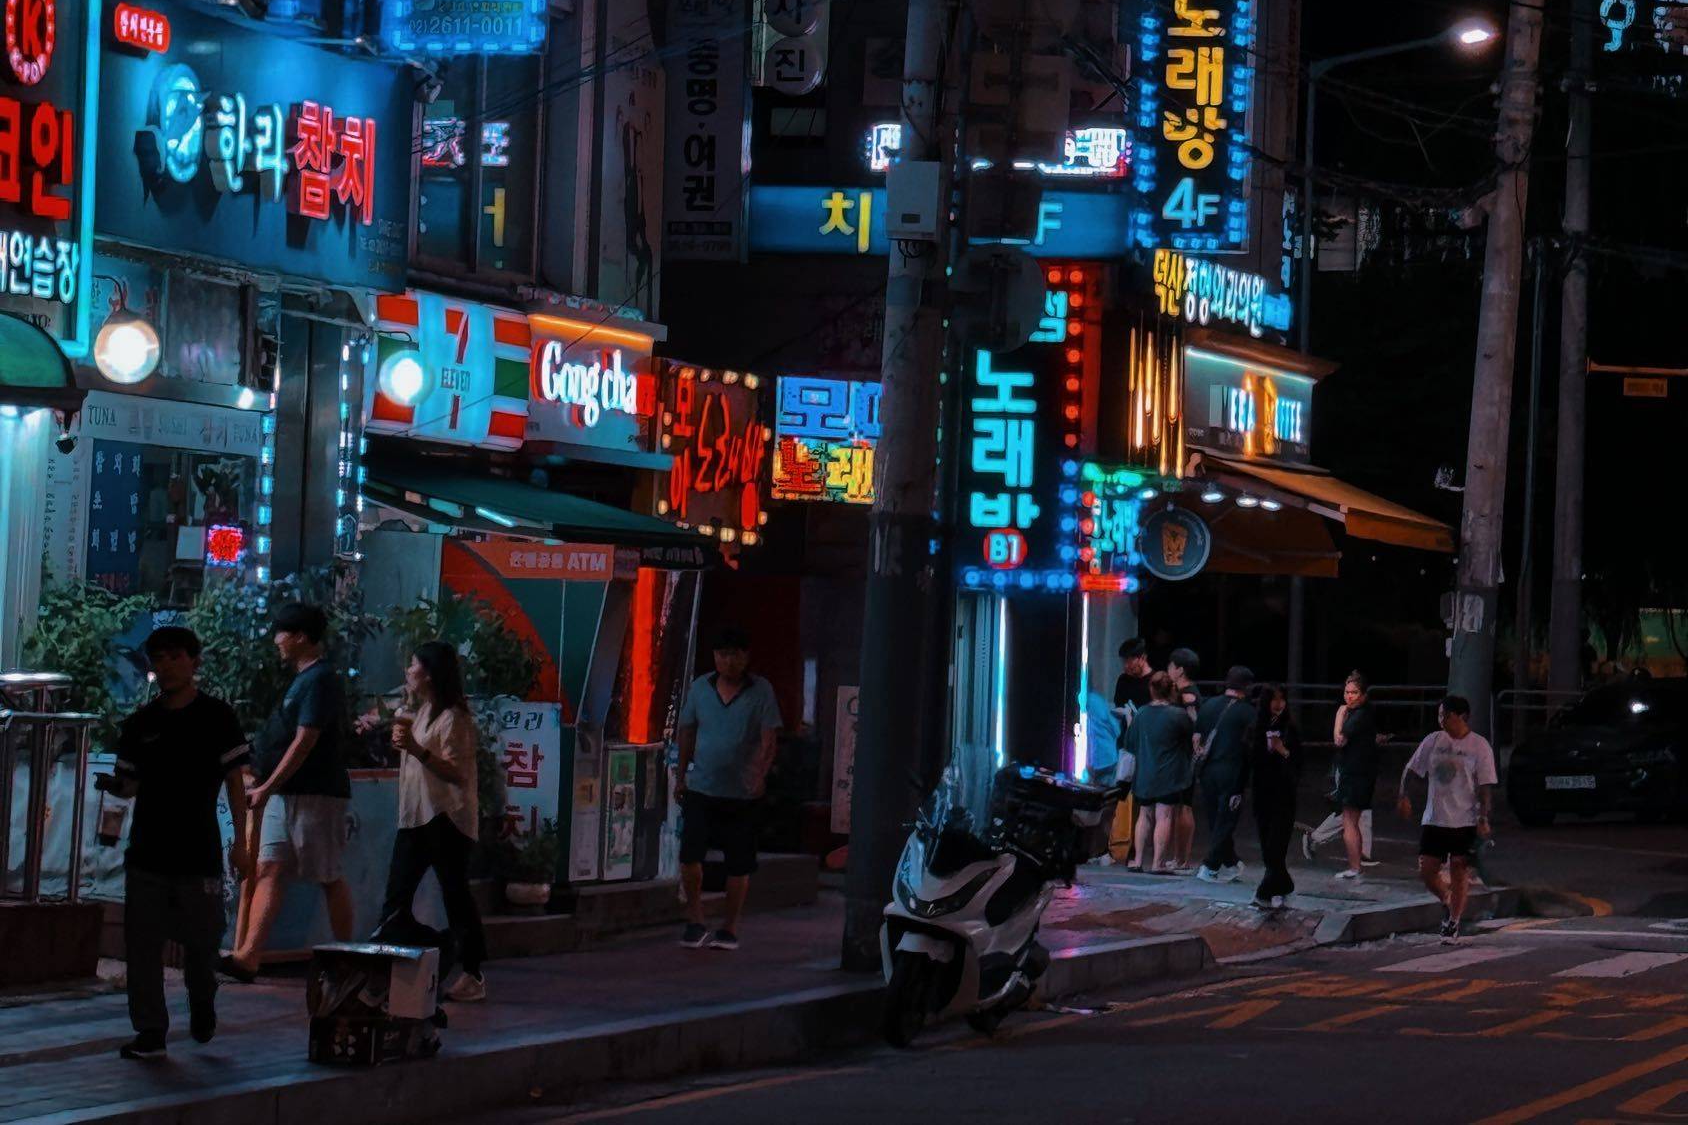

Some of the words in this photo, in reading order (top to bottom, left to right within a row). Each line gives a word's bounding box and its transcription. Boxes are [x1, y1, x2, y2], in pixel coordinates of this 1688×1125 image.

[294, 99, 376, 225] 참치
[1163, 176, 1221, 229] 4F
[567, 551, 607, 571] ATM
[988, 532, 1021, 565] B1
